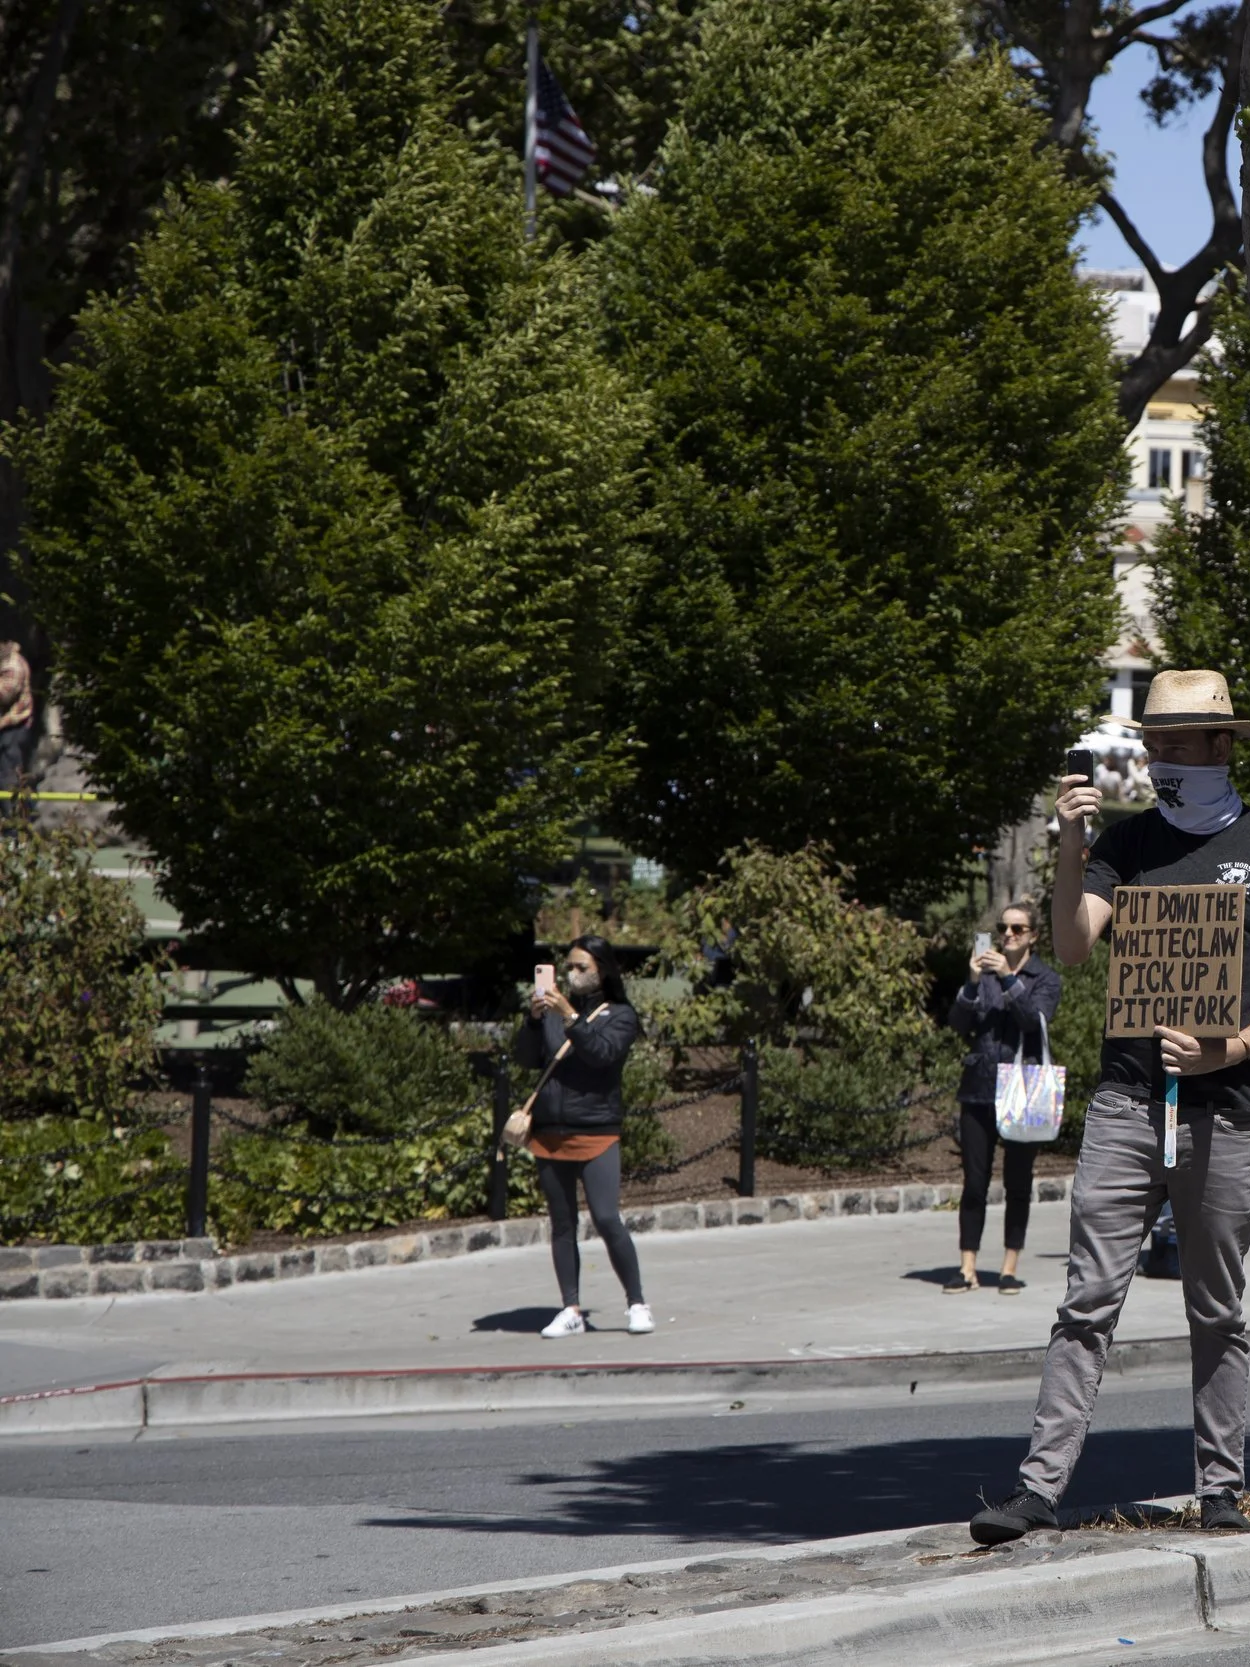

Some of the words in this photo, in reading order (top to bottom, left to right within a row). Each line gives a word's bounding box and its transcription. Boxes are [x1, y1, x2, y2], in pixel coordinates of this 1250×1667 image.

[1217, 862, 1233, 870] THE
[1115, 890, 1151, 924] PUT
[1156, 891, 1199, 923] DOWN
[1205, 892, 1239, 921] THE
[1112, 926, 1240, 959] WHITECLAW
[1119, 960, 1175, 996] PICK
[1181, 962, 1209, 991] UP
[1216, 963, 1228, 990] A
[1109, 995, 1237, 1030] PITCHFORK
